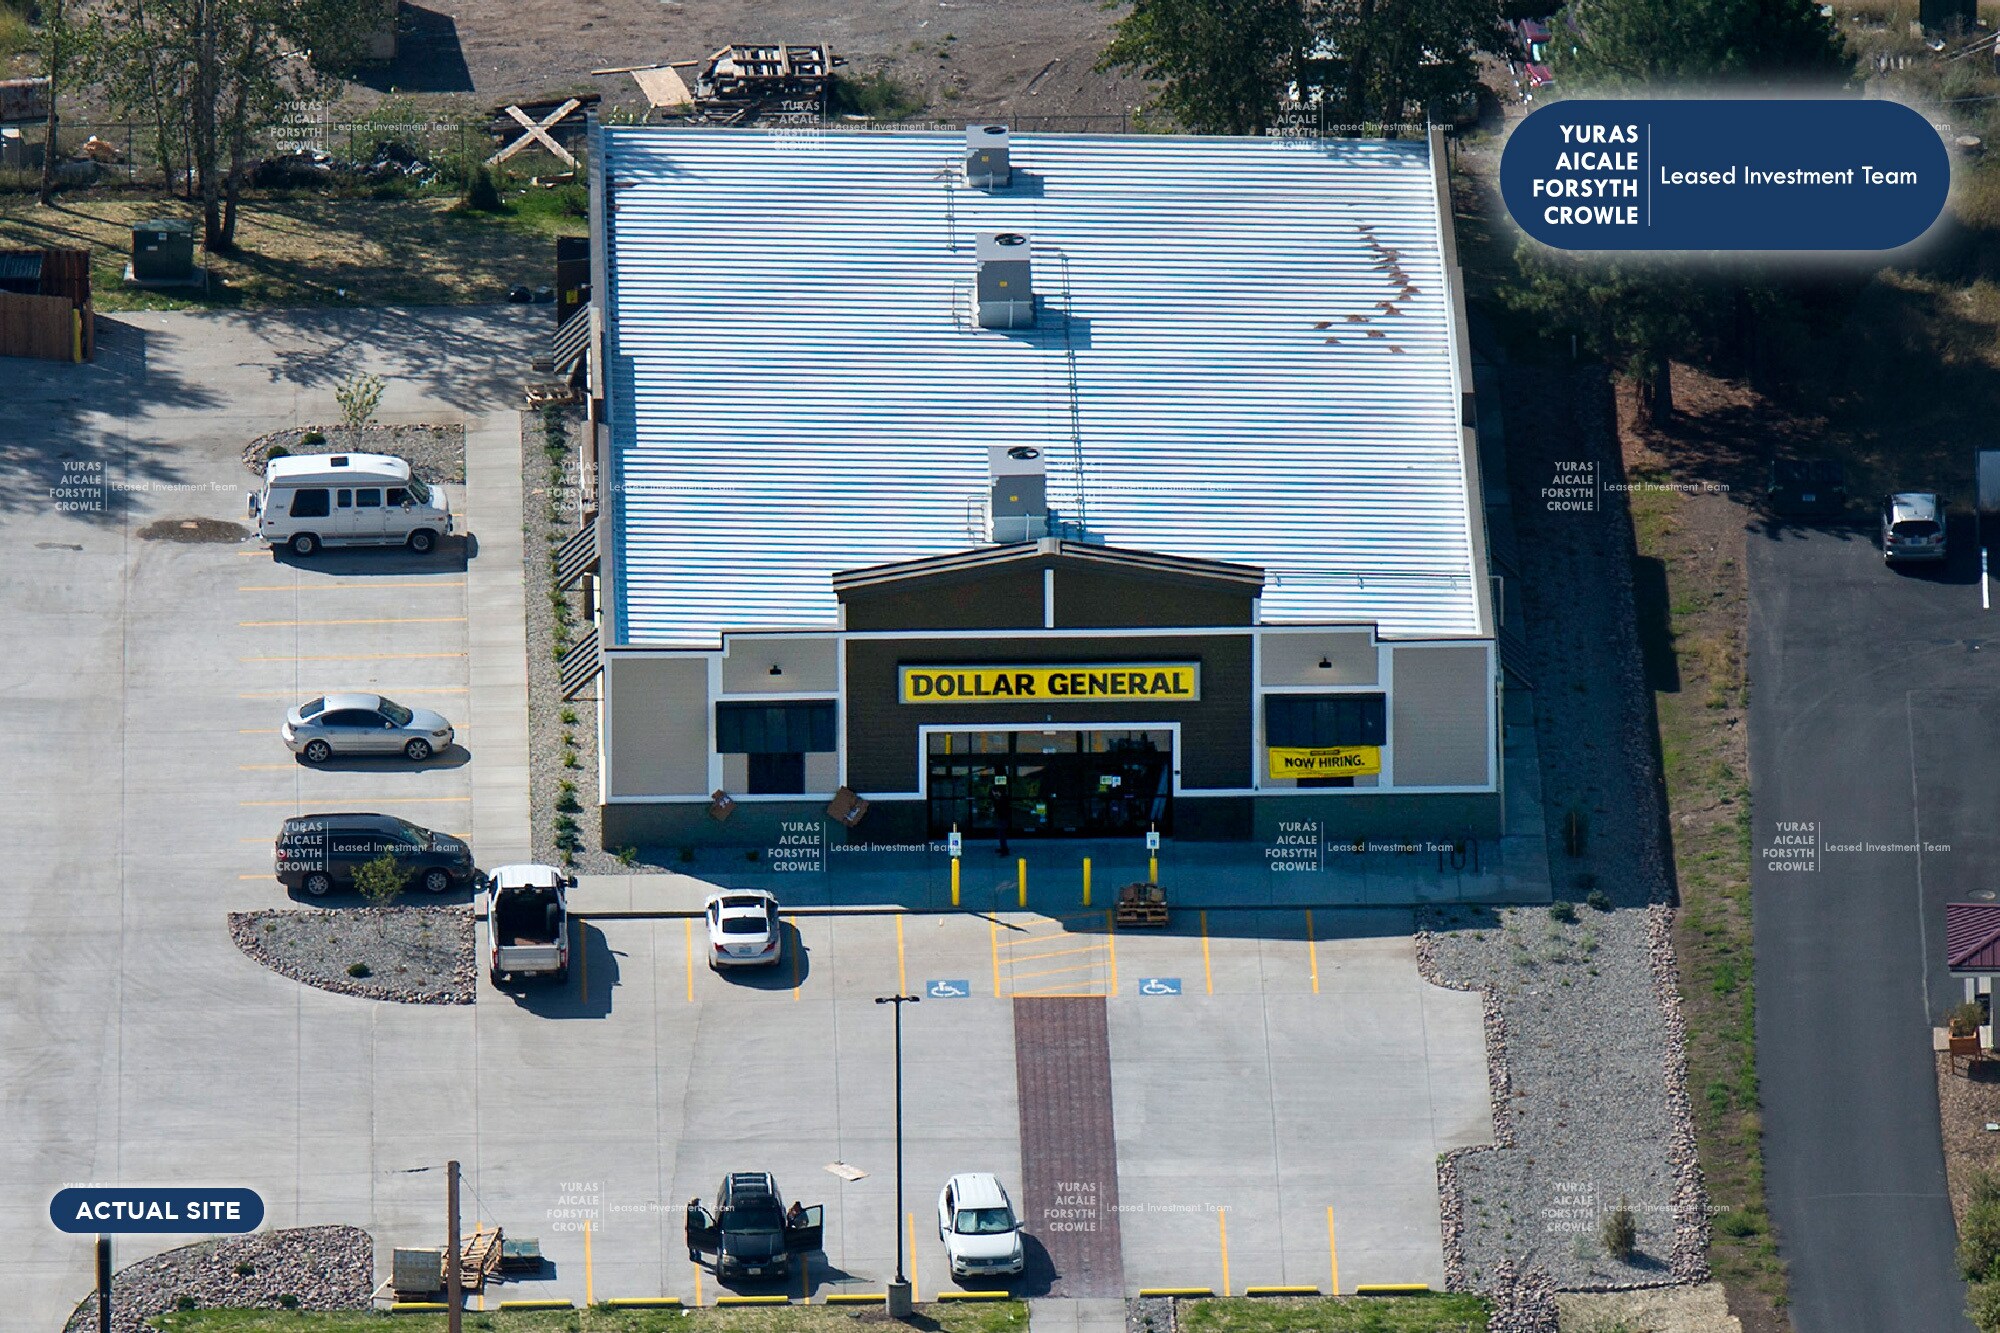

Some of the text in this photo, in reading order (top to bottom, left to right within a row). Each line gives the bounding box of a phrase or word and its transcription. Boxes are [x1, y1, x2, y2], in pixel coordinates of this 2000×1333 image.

[911, 672, 1189, 696] DOLLAR GENERAL
[1284, 755, 1365, 768] NOW HIRING.
